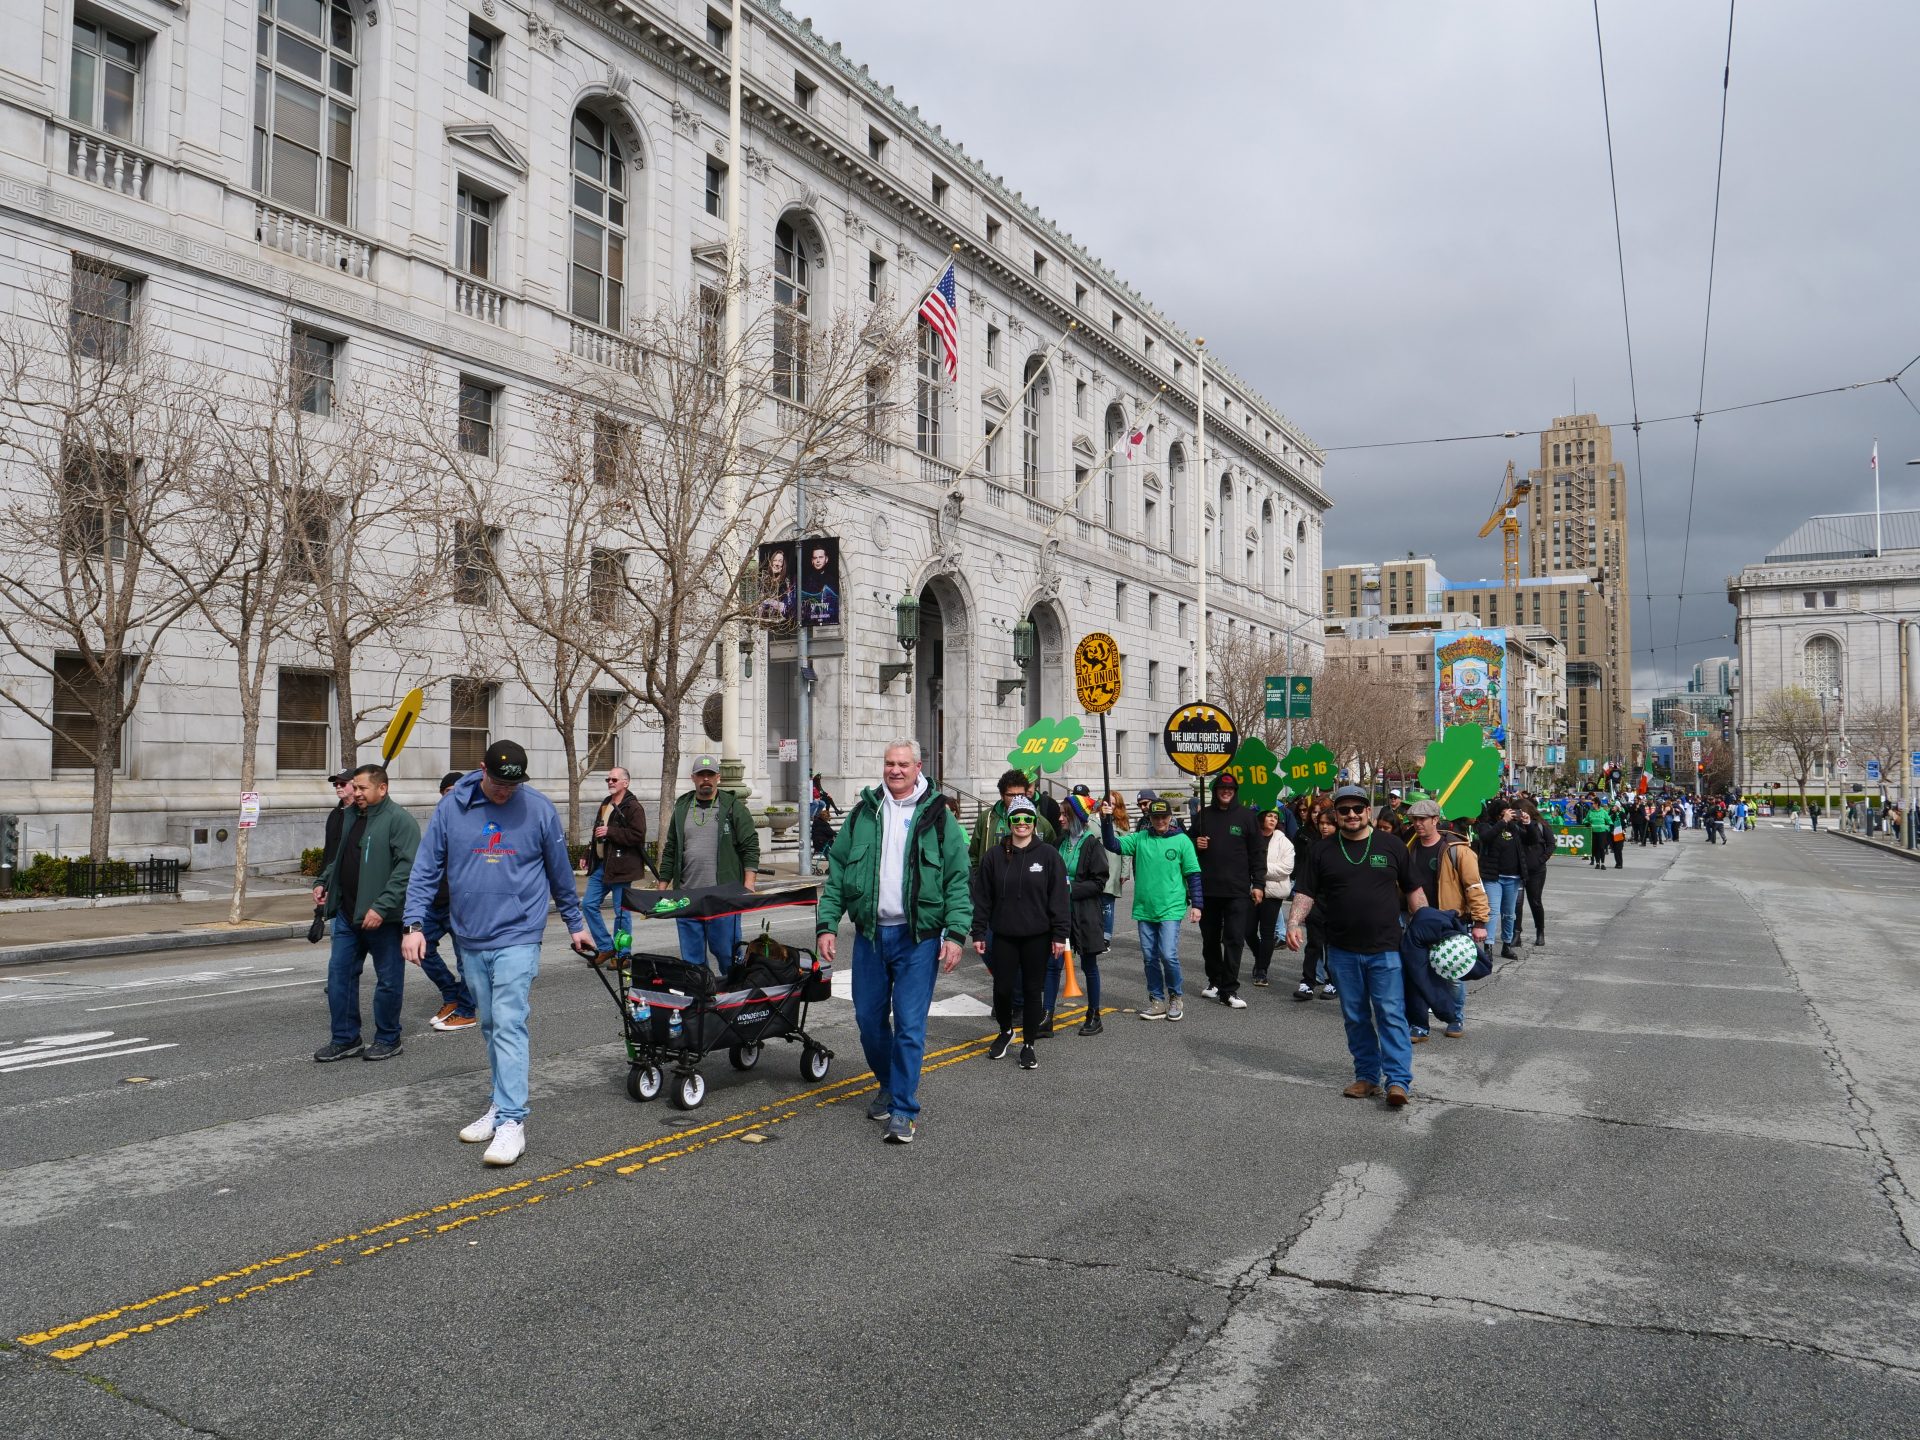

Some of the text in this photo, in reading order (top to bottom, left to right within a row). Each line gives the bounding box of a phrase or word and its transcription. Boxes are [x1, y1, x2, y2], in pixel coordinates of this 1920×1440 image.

[1076, 633, 1119, 674] PAINTERS AND ALLIED TRADES
[1077, 668, 1119, 688] ONE UNION
[1078, 688, 1113, 712] INTERNATIONAL
[1022, 737, 1069, 753] DC 16
[1171, 732, 1231, 742] THE IUPAT FIGHTS FOR
[1177, 743, 1225, 752] WORKING PEOPLE
[1249, 765, 1268, 785] 16
[1292, 761, 1327, 779] DC 16
[1554, 834, 1584, 848] ERS
